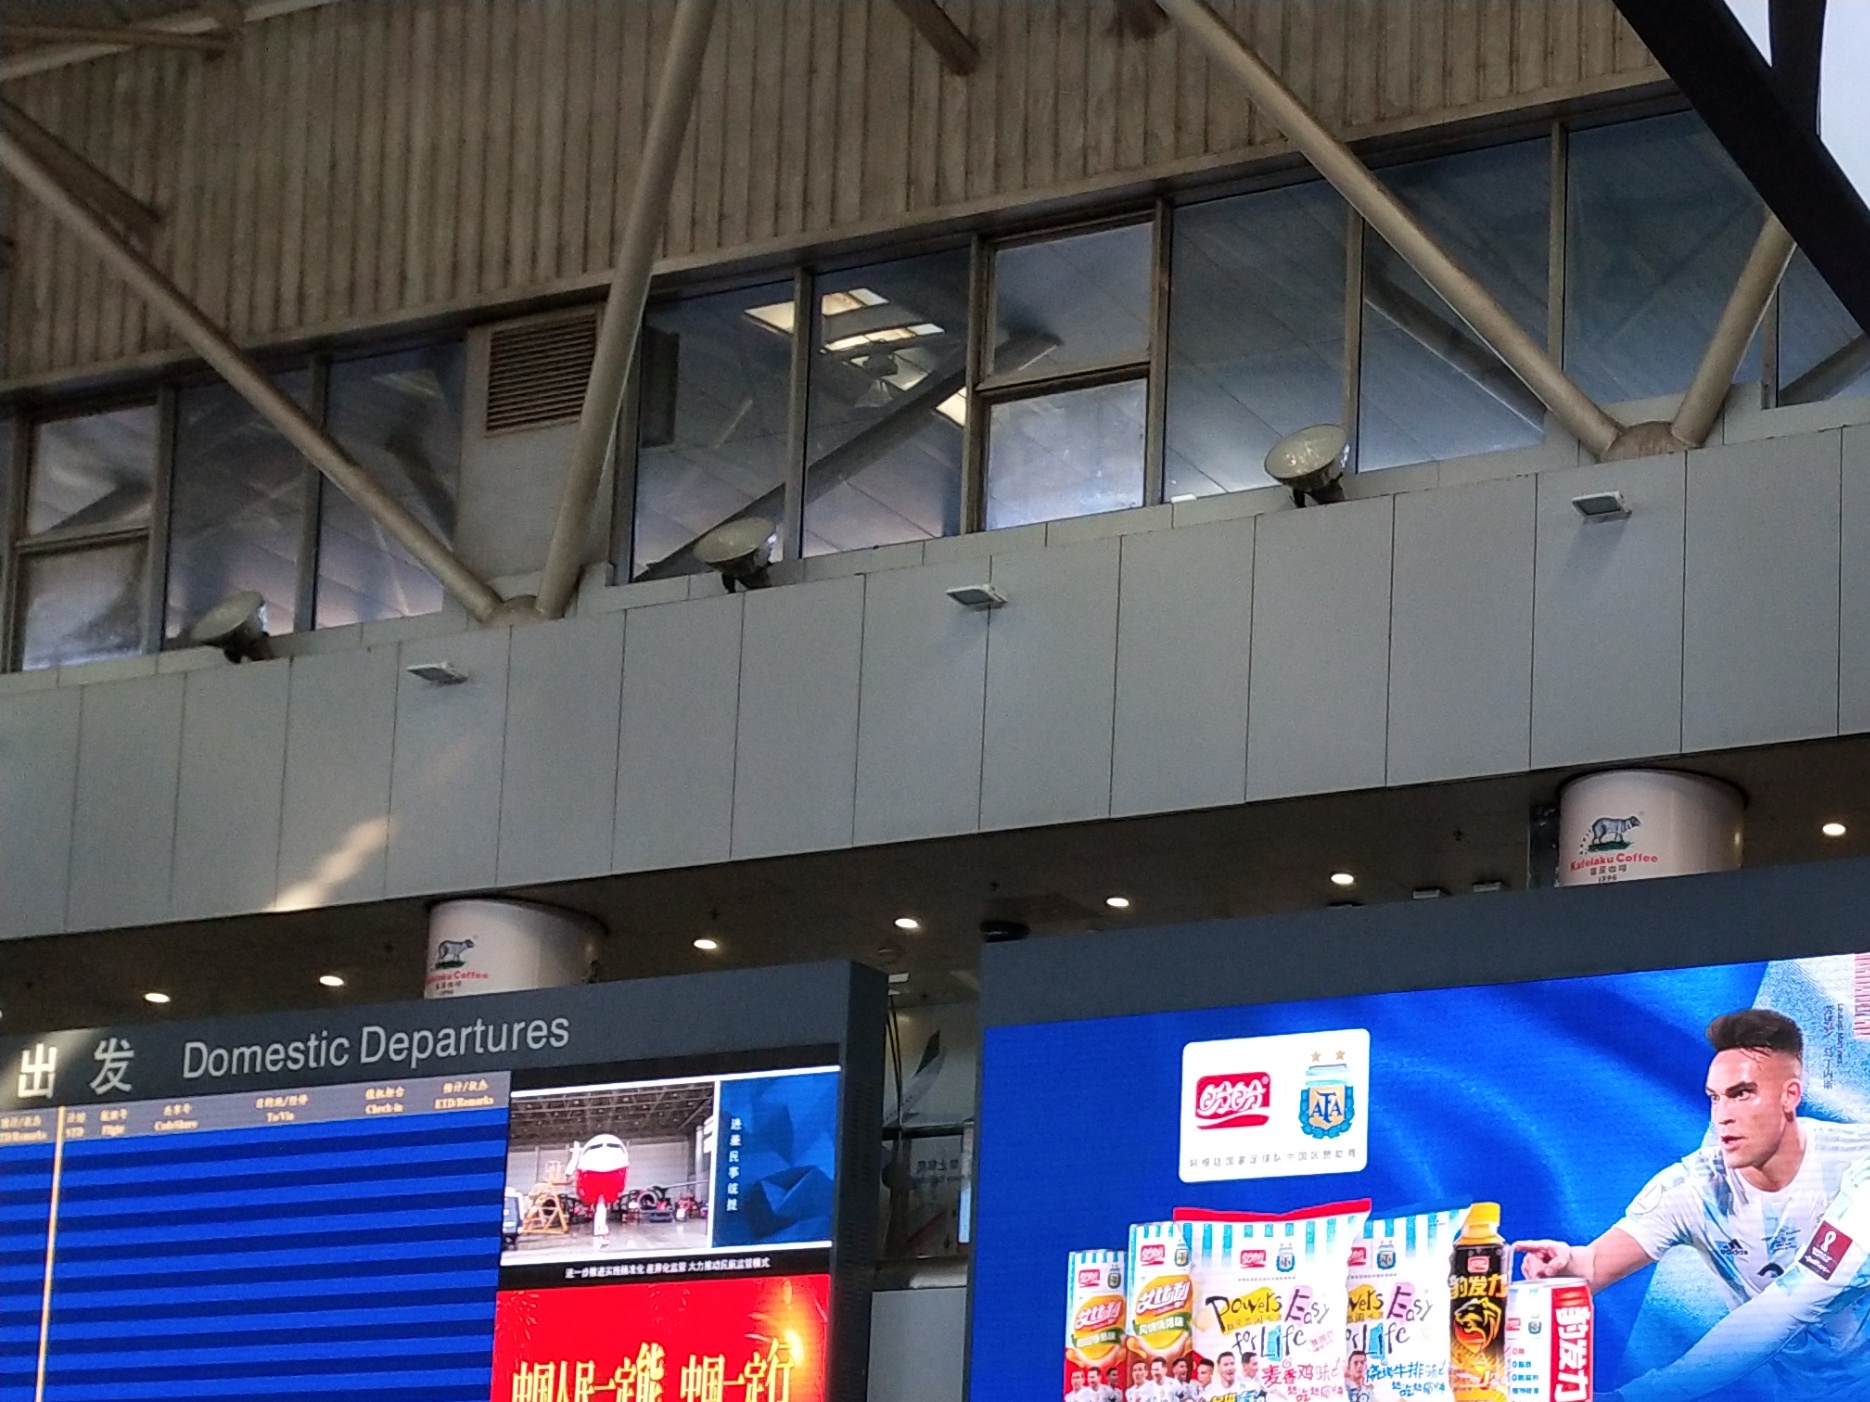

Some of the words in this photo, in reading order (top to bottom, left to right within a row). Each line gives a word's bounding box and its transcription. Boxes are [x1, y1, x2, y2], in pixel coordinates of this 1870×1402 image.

[1570, 854, 1614, 871] Kafelaku
[1616, 852, 1658, 864] Coffee
[182, 1030, 350, 1079] Domestic
[360, 1016, 570, 1069] Departures
[1284, 1288, 1330, 1324] Easy
[1387, 1285, 1433, 1322] Easy
[1232, 1330, 1257, 1356] for
[1260, 1324, 1307, 1358] Life
